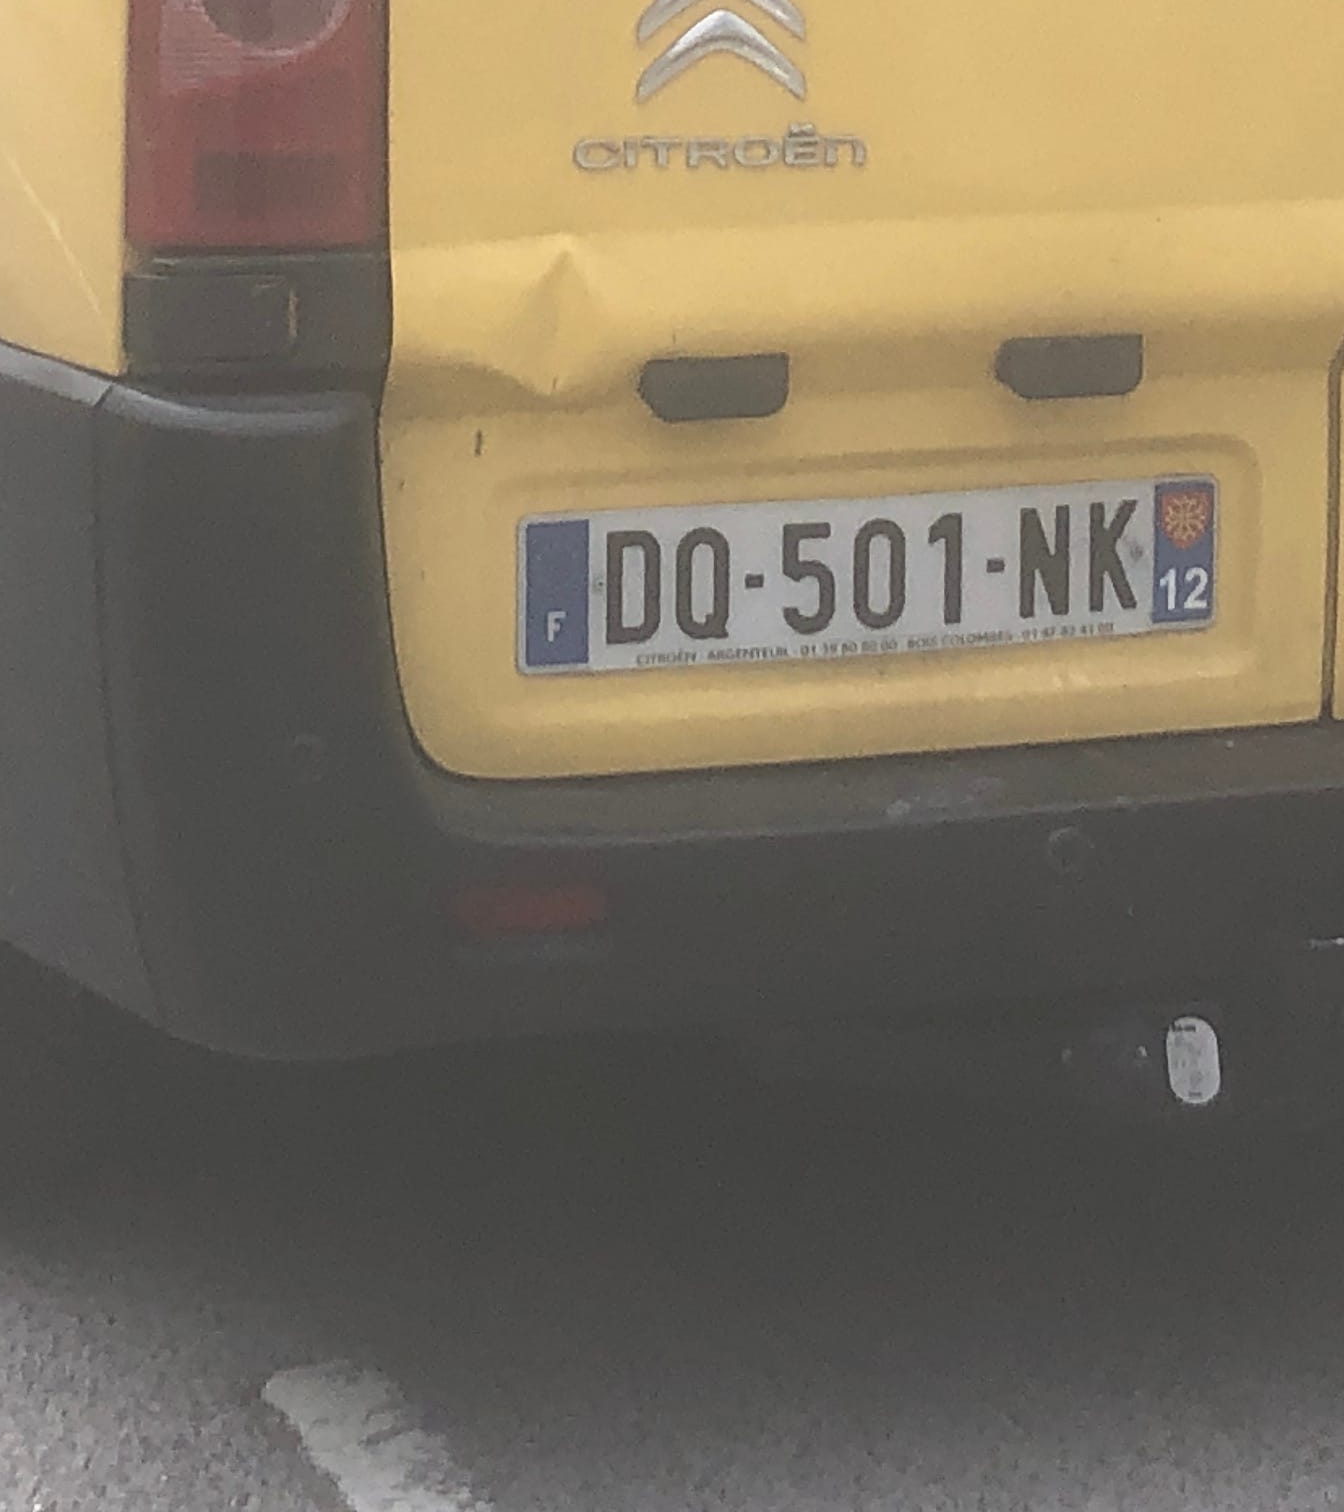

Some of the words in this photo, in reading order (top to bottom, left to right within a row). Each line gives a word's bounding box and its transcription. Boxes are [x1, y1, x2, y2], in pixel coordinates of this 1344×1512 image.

[605, 498, 1137, 644] DQ-501-NK
[1158, 565, 1209, 610] 12
[545, 611, 566, 642] F
